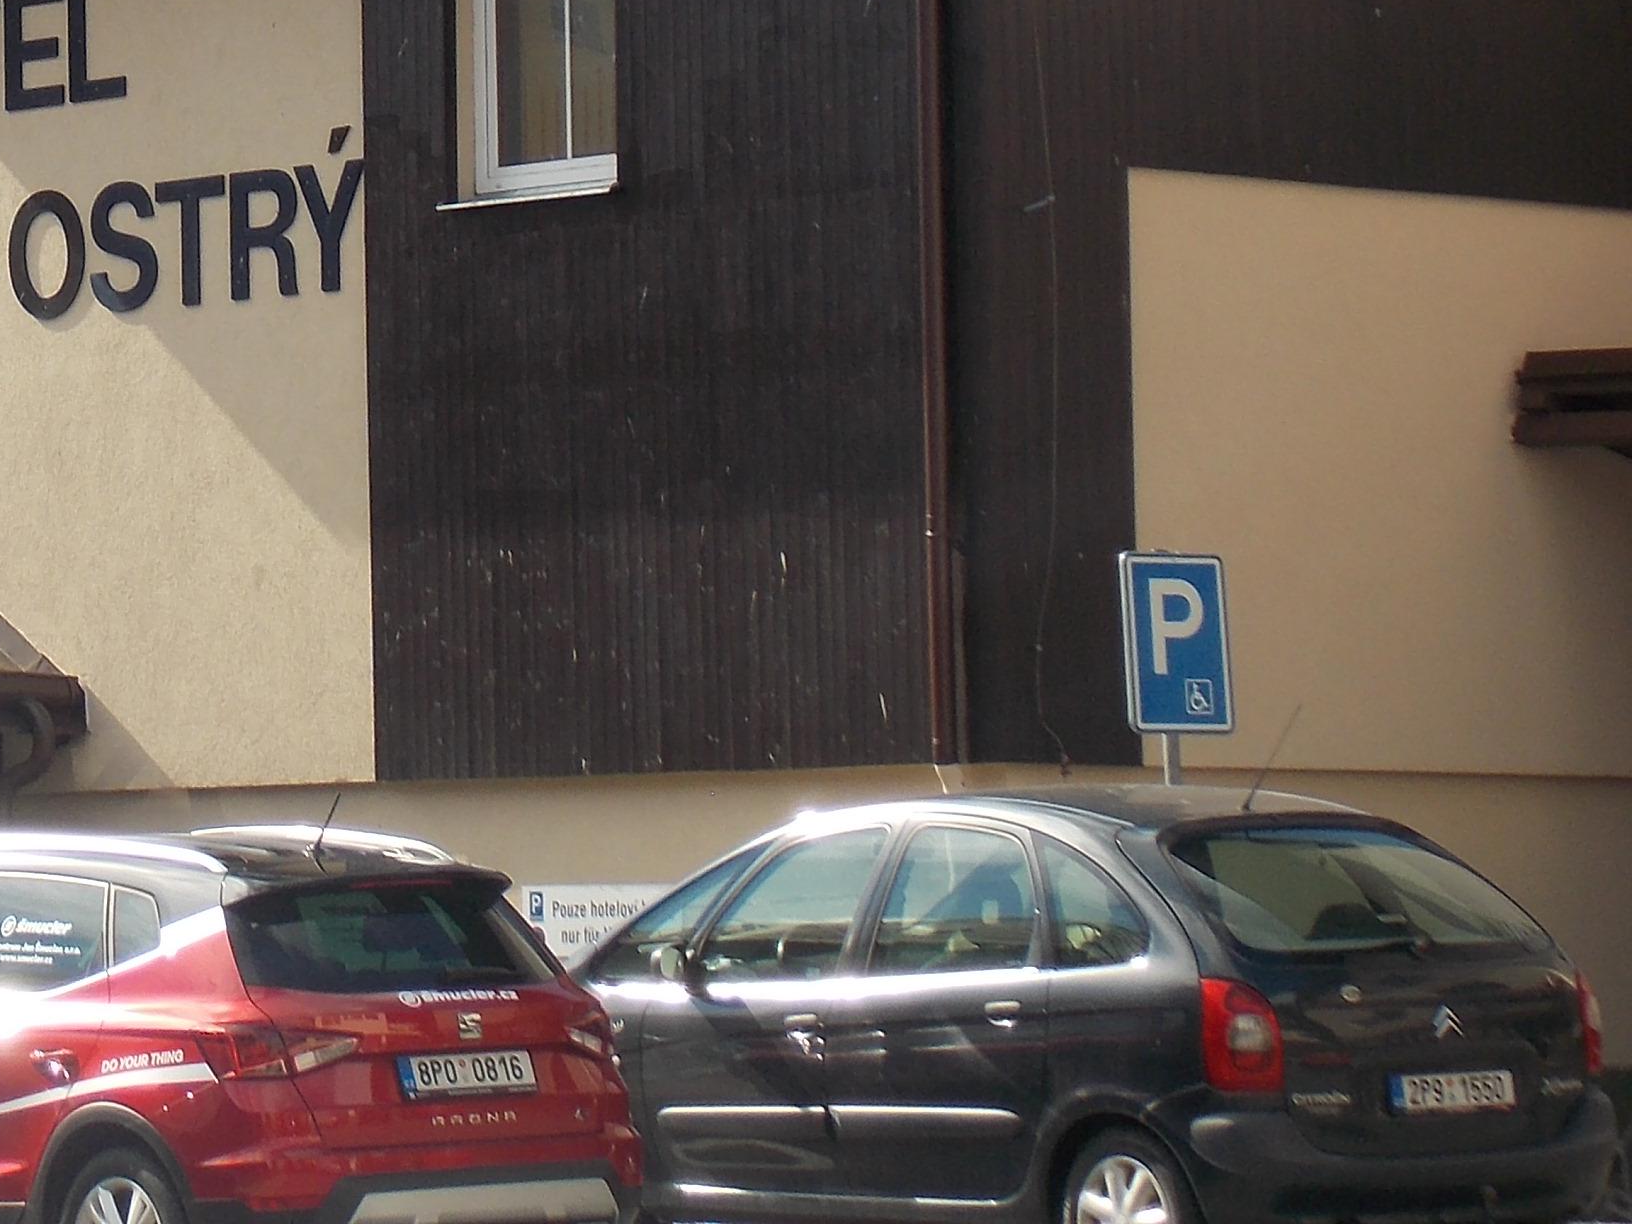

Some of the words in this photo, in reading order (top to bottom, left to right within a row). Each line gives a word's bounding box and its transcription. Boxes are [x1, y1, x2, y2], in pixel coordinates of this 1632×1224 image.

[8, 126, 365, 320] OSTRÝ
[1148, 578, 1203, 675] P
[552, 900, 587, 918] Pouze
[561, 931, 580, 944] nur
[101, 1059, 118, 1073] DO
[119, 1054, 149, 1070] YOUR
[151, 1049, 184, 1066] THING
[472, 1055, 523, 1083] 0816
